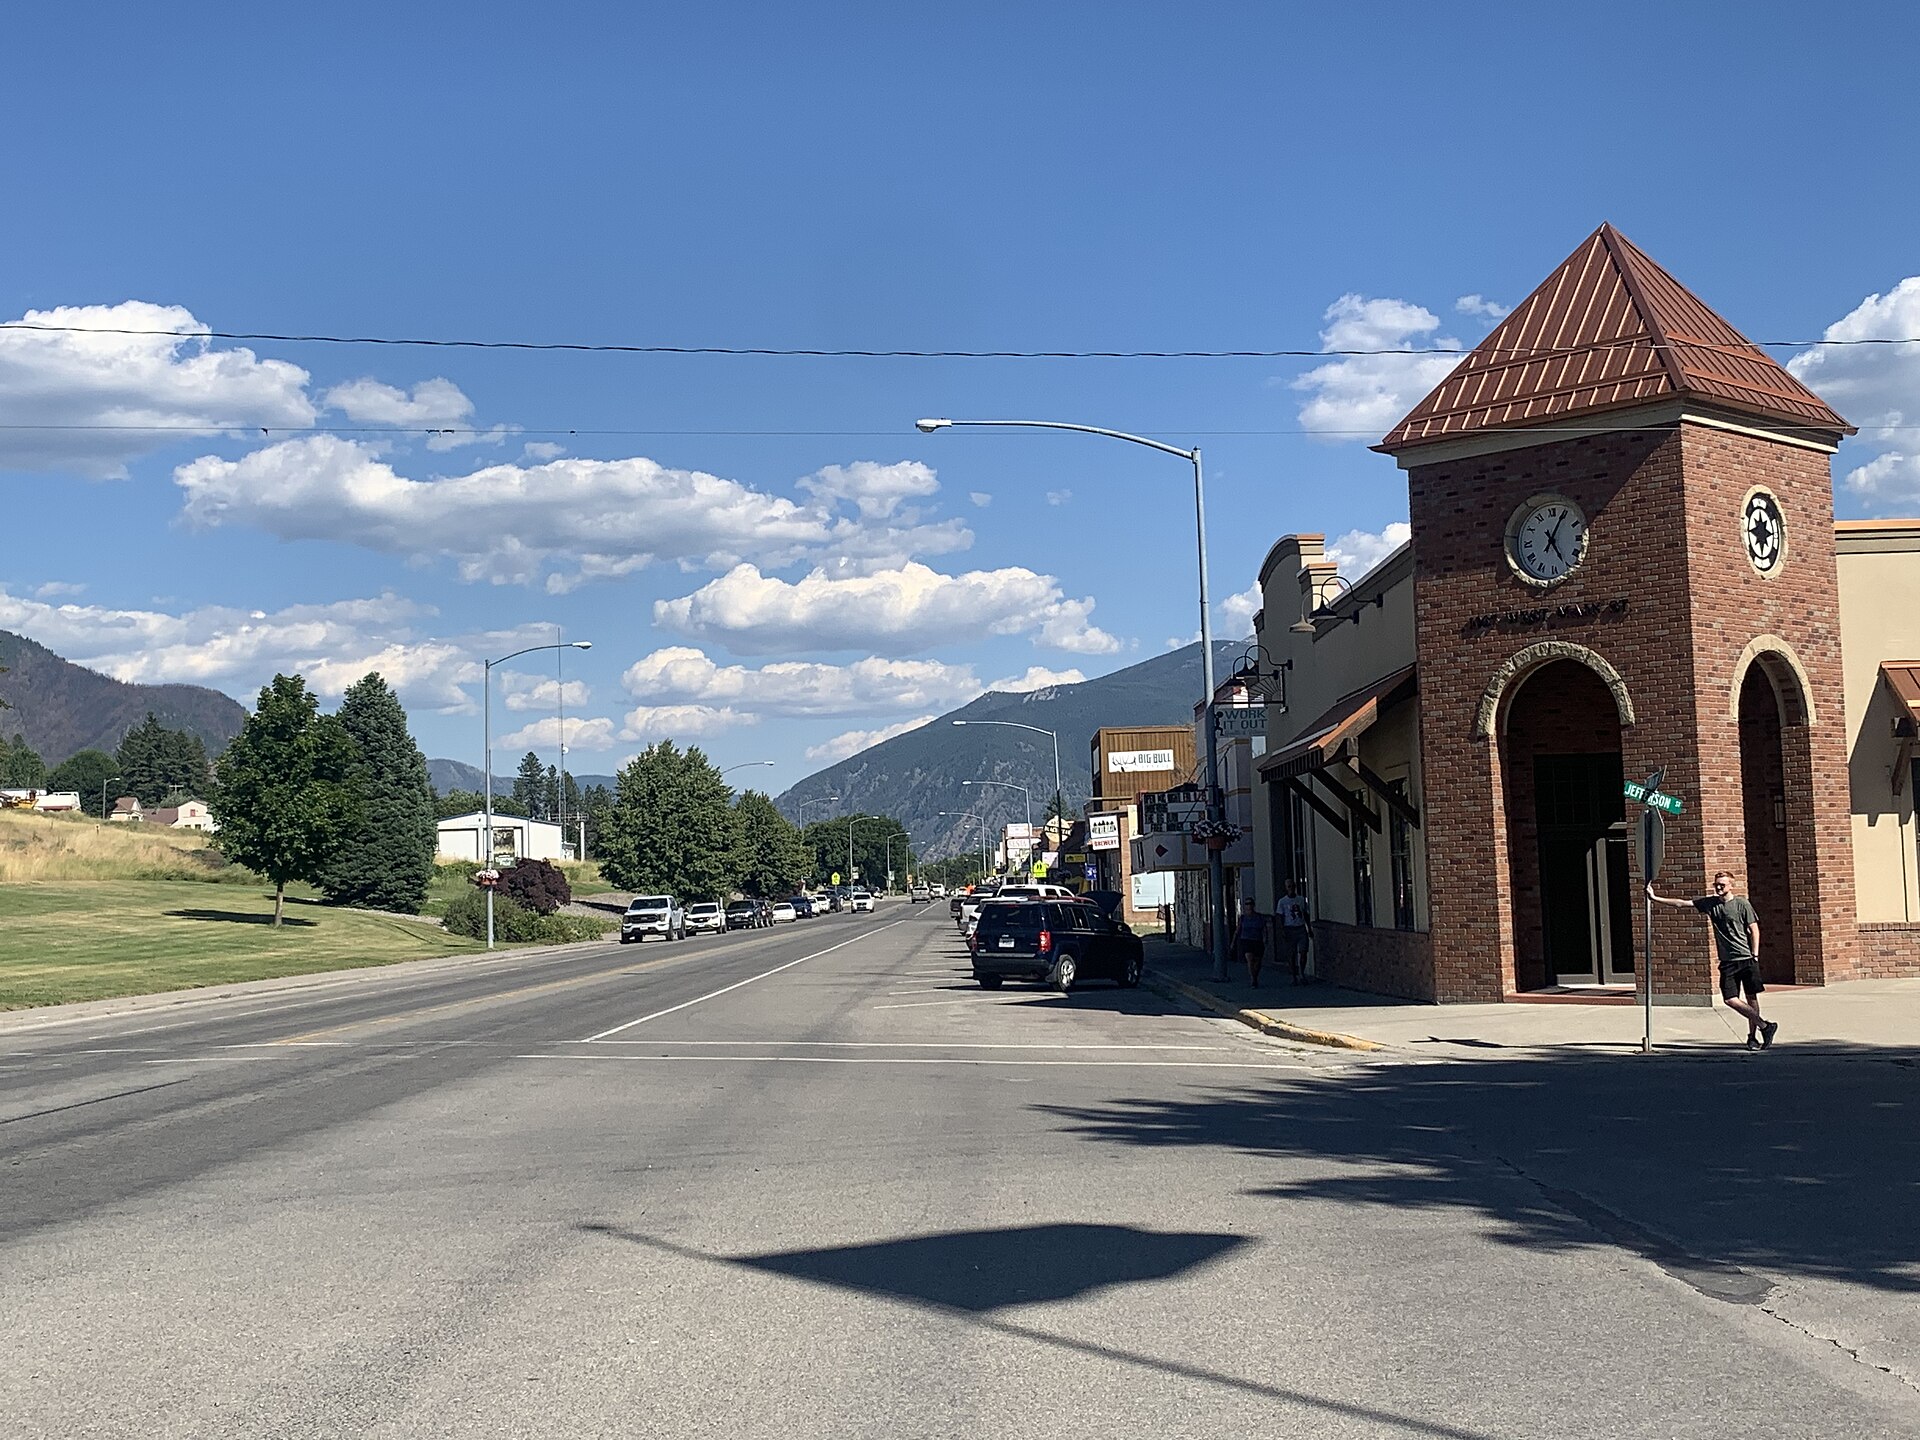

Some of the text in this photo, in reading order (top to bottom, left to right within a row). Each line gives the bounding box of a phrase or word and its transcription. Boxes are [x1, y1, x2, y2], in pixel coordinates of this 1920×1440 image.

[1225, 710, 1266, 719] WORK
[1223, 719, 1268, 730] IT OUT
[1138, 753, 1171, 763] BIG BULL
